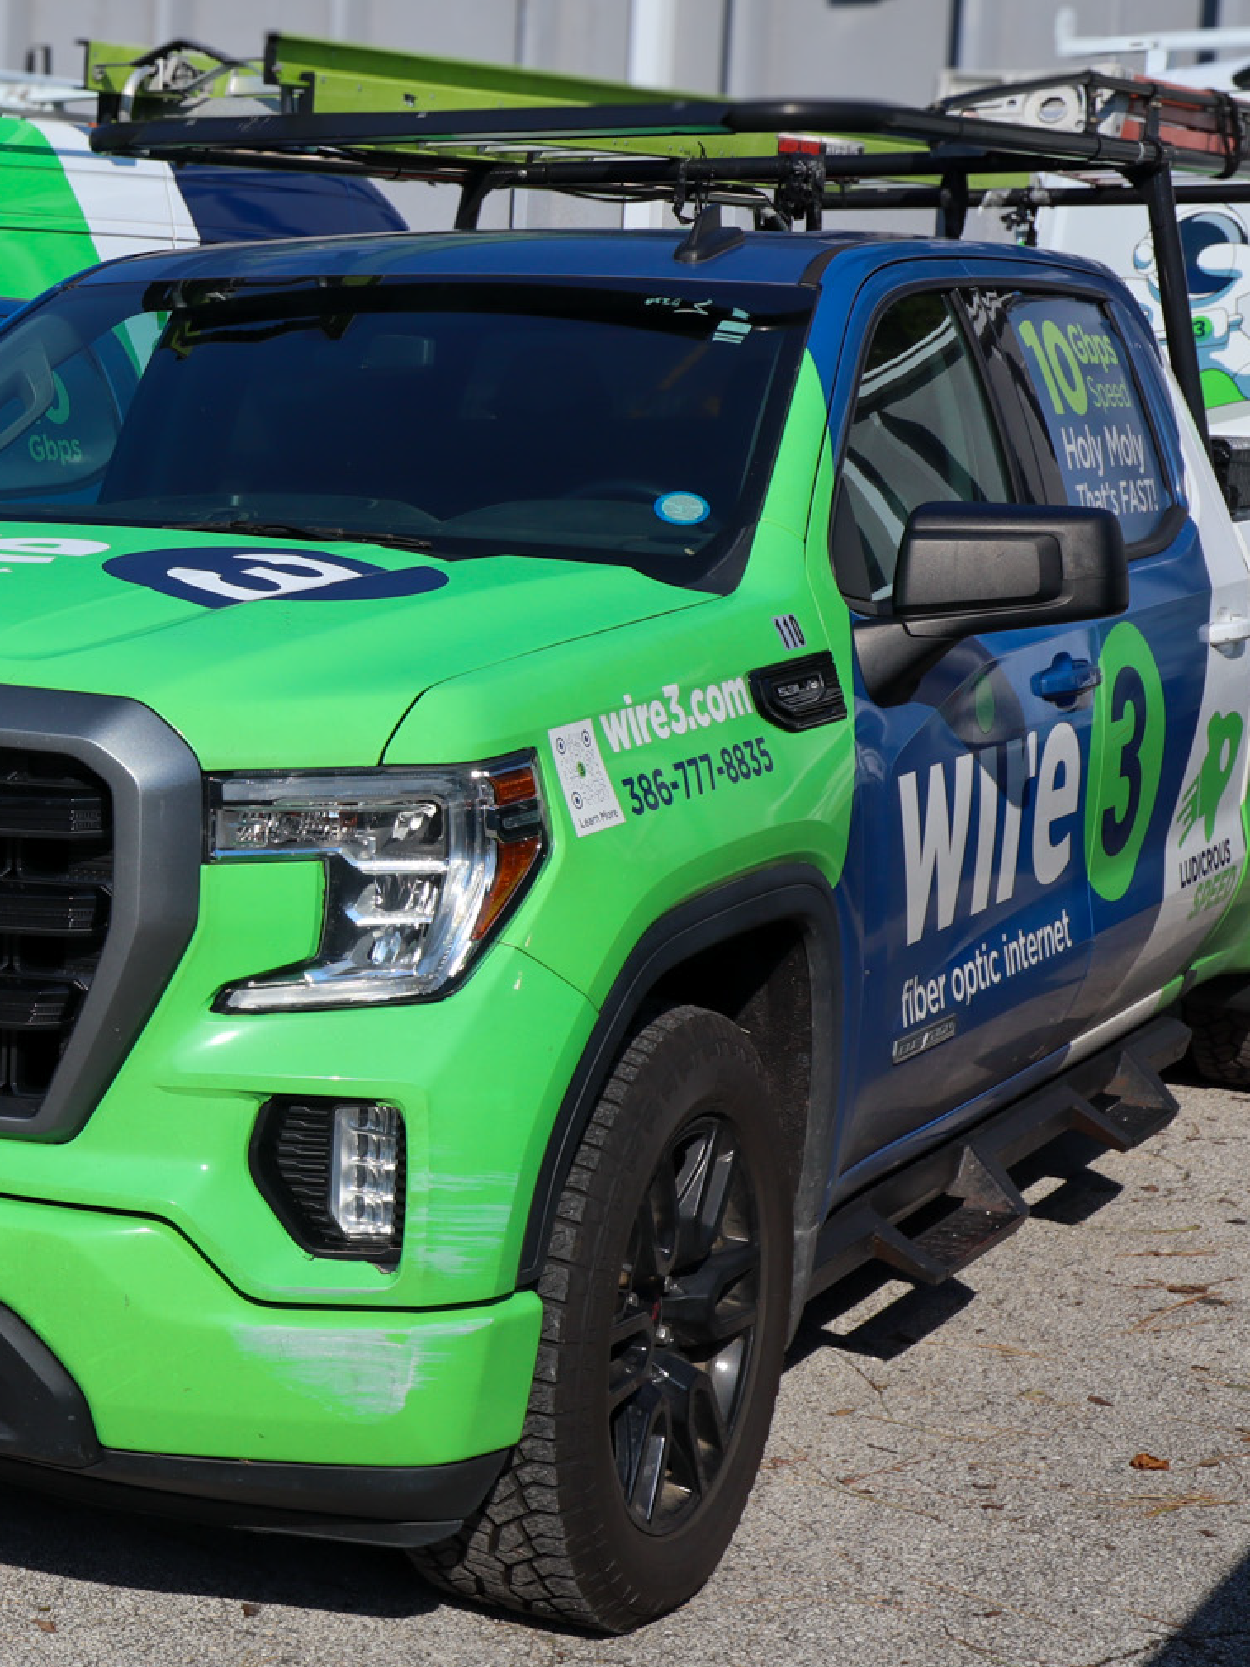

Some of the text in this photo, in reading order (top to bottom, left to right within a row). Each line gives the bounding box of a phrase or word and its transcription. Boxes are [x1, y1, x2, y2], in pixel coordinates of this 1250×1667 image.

[1018, 319, 1119, 416] 10 Gbps
[1086, 375, 1132, 414] Speed
[28, 434, 82, 466] Gbps
[1061, 423, 1145, 478] Holy Moly
[1075, 478, 1159, 516] That's FAST!
[774, 614, 805, 650] 110
[599, 675, 754, 753] wire3.com
[621, 737, 774, 816] 386-777-8835
[578, 814, 599, 830] Learn
[898, 665, 1147, 947] wire 3
[1178, 838, 1232, 889] LUDICROUS
[901, 910, 1073, 1029] fiber optic internet
